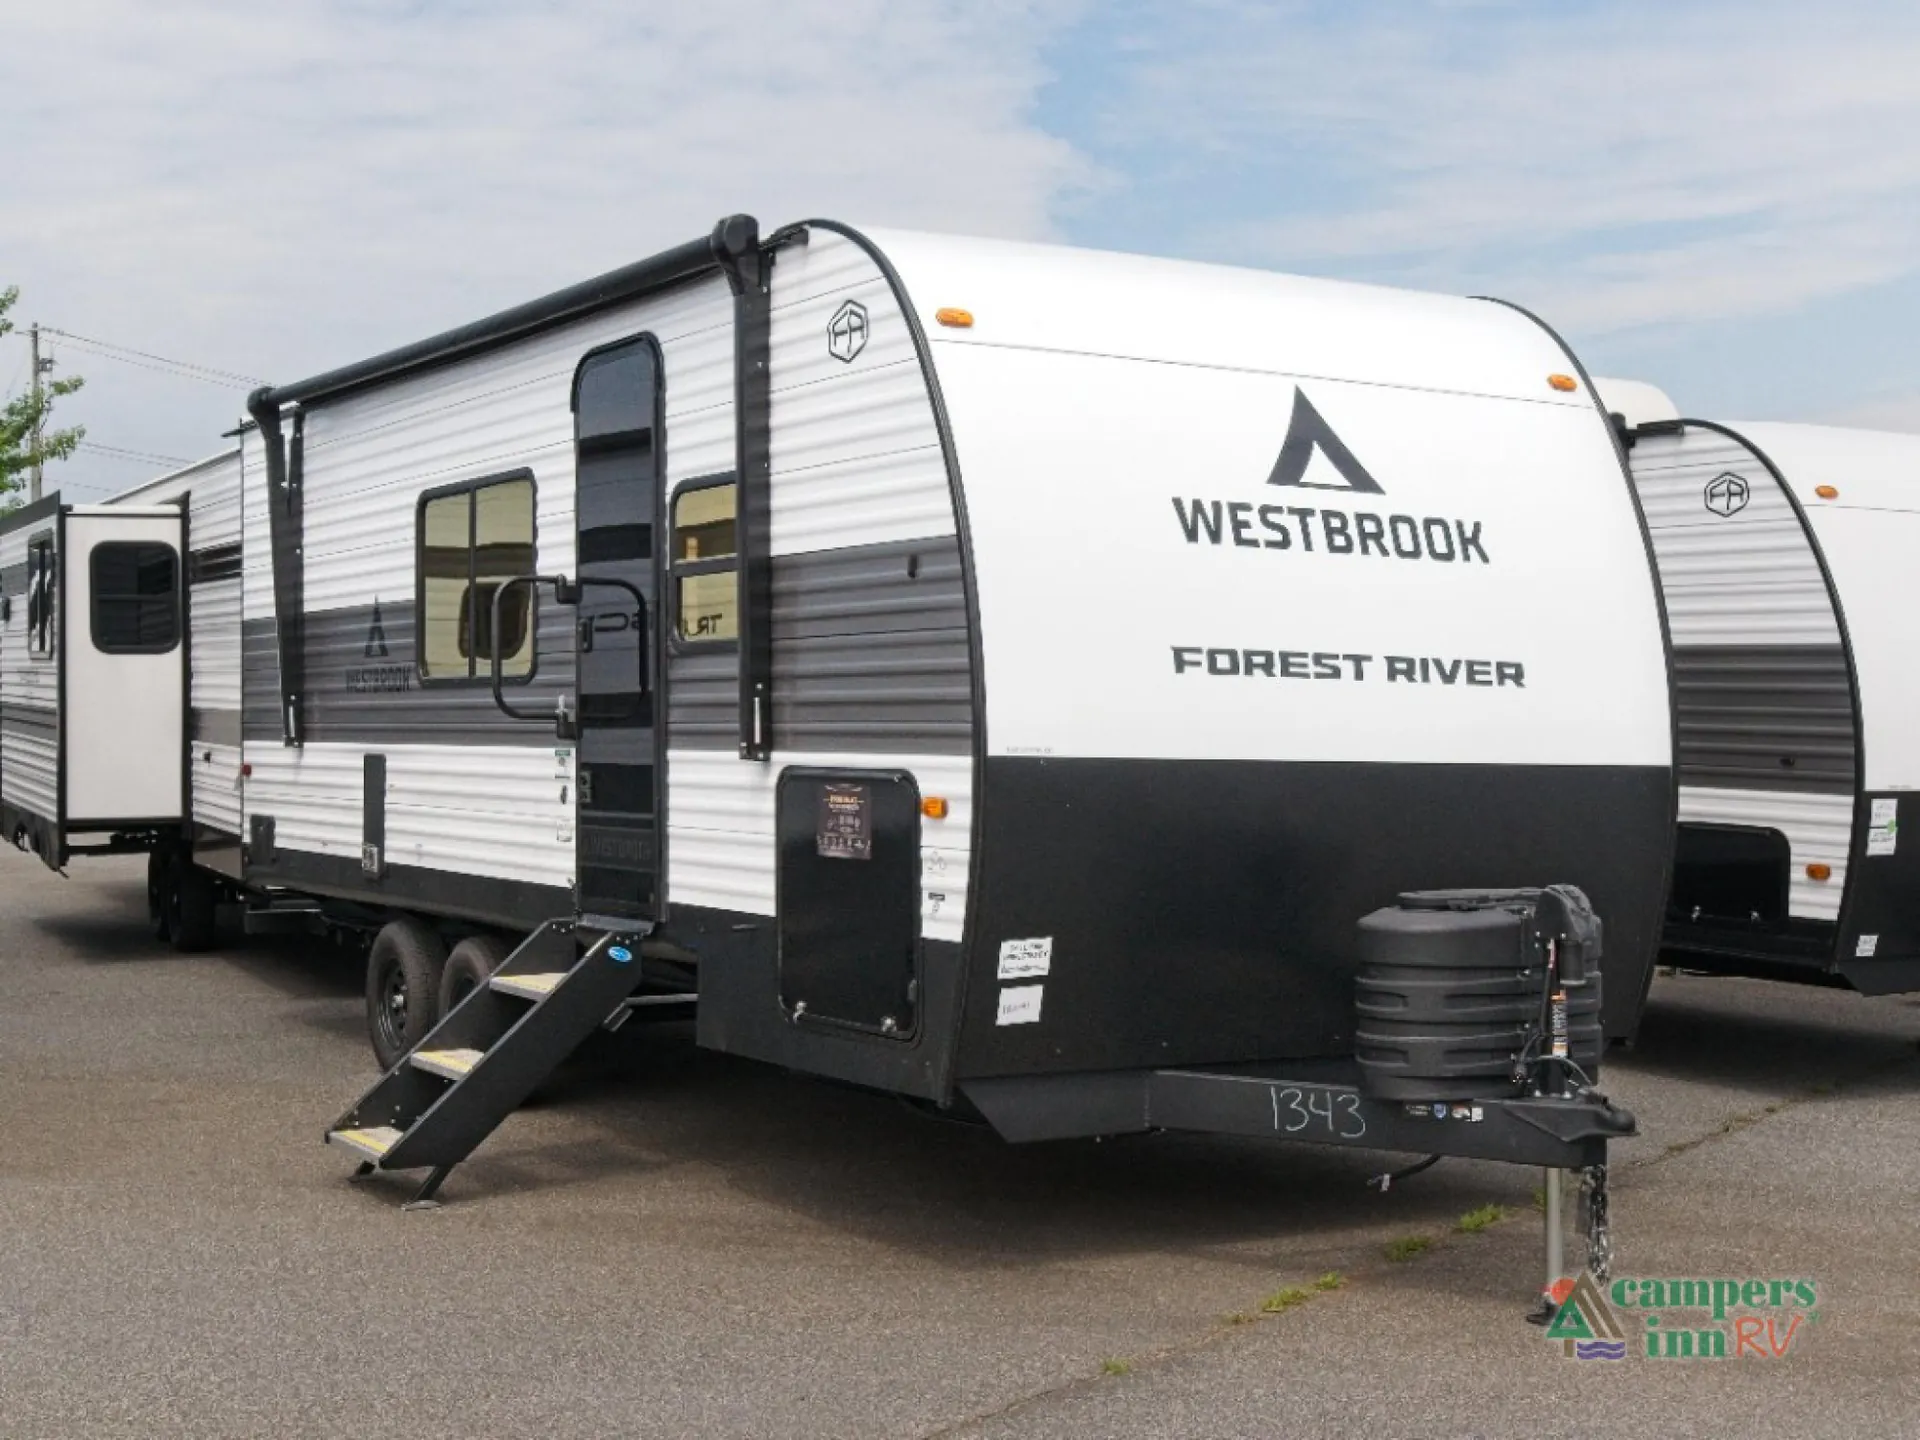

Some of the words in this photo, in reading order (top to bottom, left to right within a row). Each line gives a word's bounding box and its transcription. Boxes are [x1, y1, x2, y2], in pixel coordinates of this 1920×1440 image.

[1172, 497, 1490, 564] WESTBROOK
[345, 666, 411, 693] WESTBROOK
[1171, 646, 1372, 682] FOREST
[1384, 656, 1526, 688] RIVER
[1270, 1086, 1366, 1138] 1343
